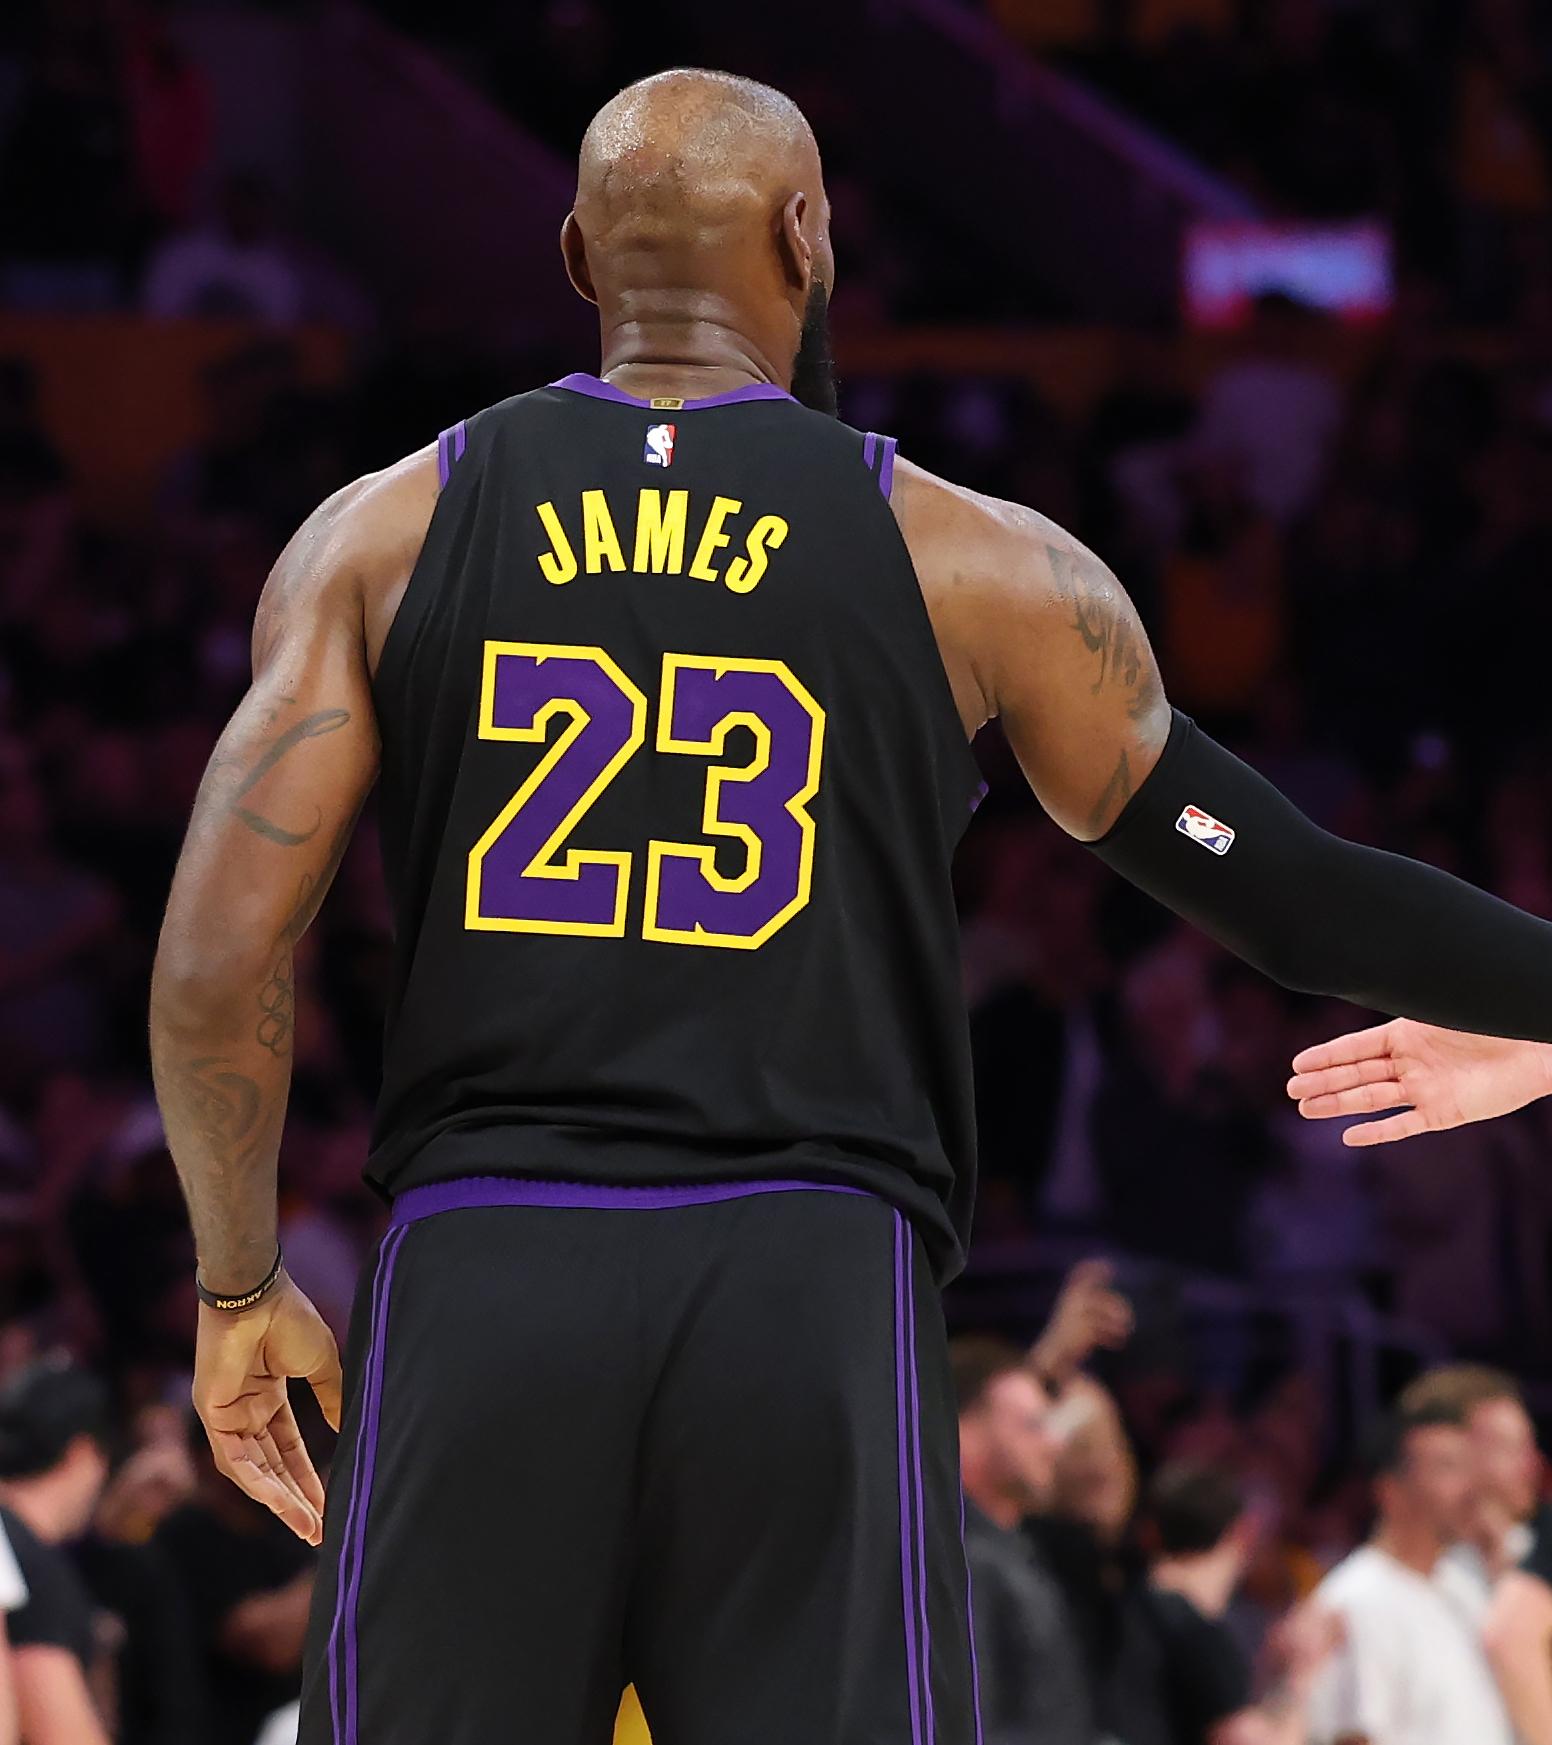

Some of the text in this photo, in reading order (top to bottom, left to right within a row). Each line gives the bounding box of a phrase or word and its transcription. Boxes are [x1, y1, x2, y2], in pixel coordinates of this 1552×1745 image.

[536, 488, 789, 594] JAMES
[464, 639, 827, 950] 23
[216, 1289, 263, 1309] AKRON
